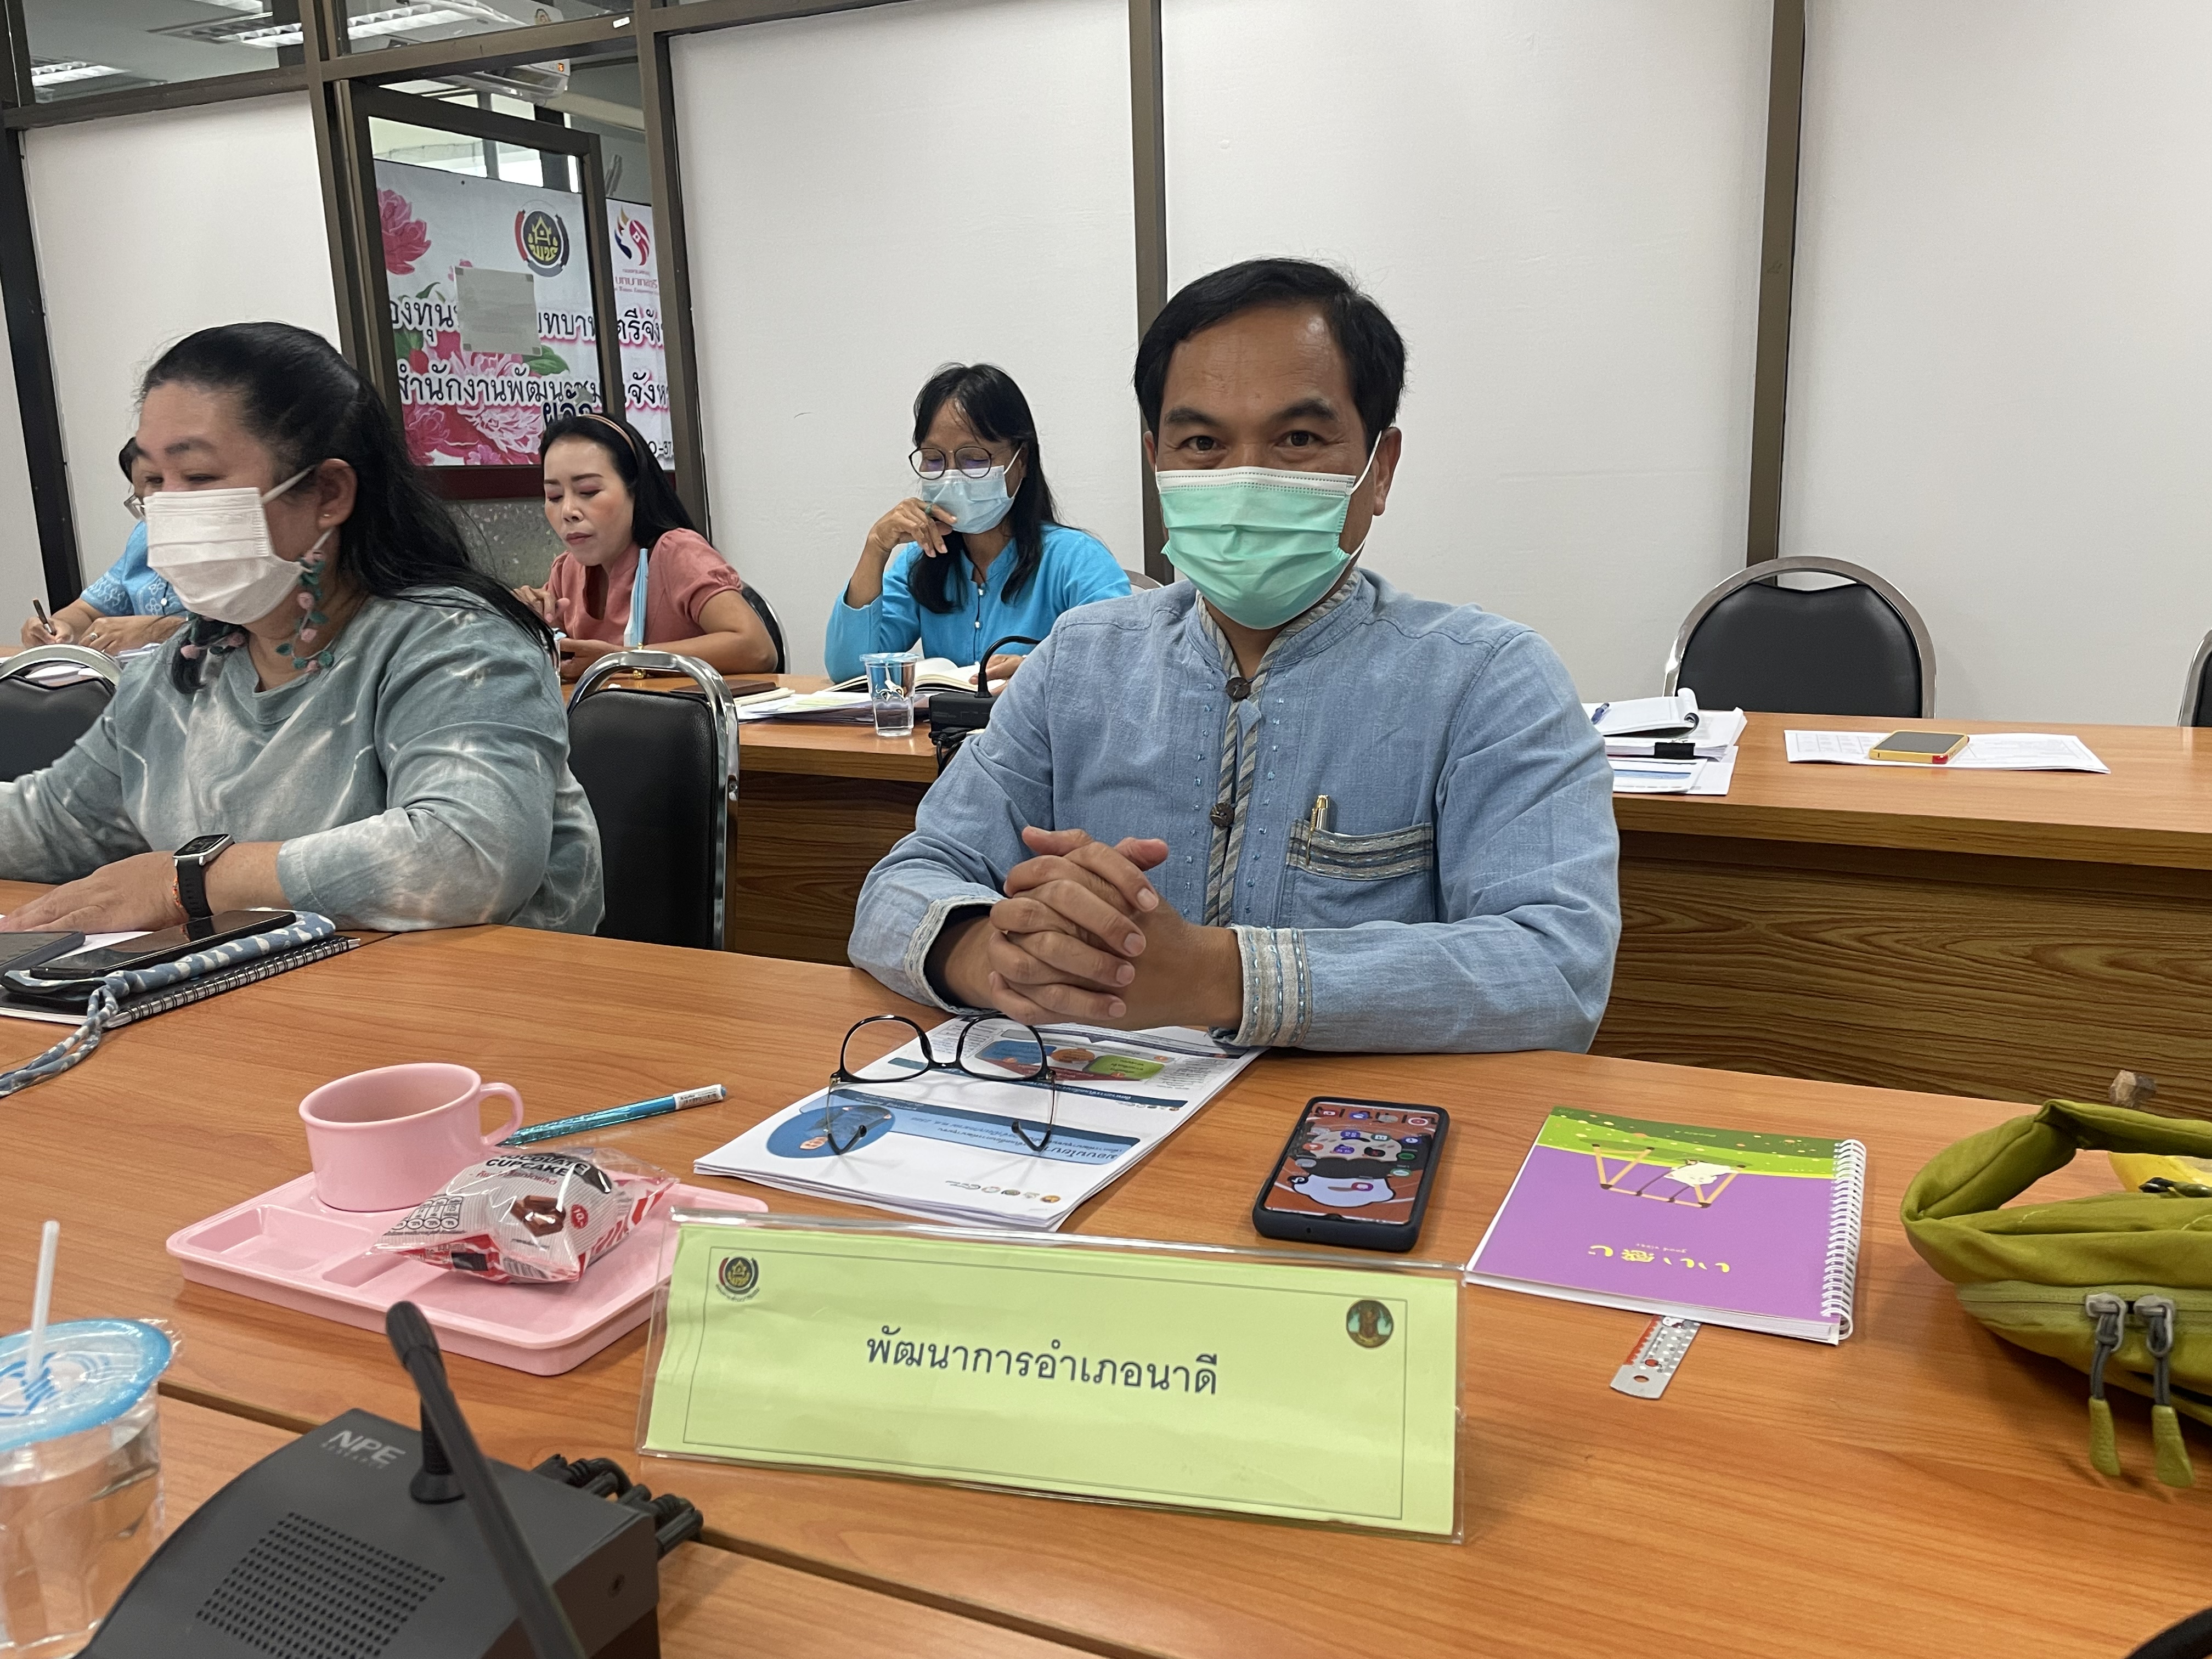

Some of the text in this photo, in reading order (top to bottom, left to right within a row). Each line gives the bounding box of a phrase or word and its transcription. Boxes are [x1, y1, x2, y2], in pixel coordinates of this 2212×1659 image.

[486, 1158, 569, 1177] CUPCAKE
[867, 1325, 1218, 1395] พัฒนาการอำเภอนาดี
[328, 1430, 406, 1464] NPE
